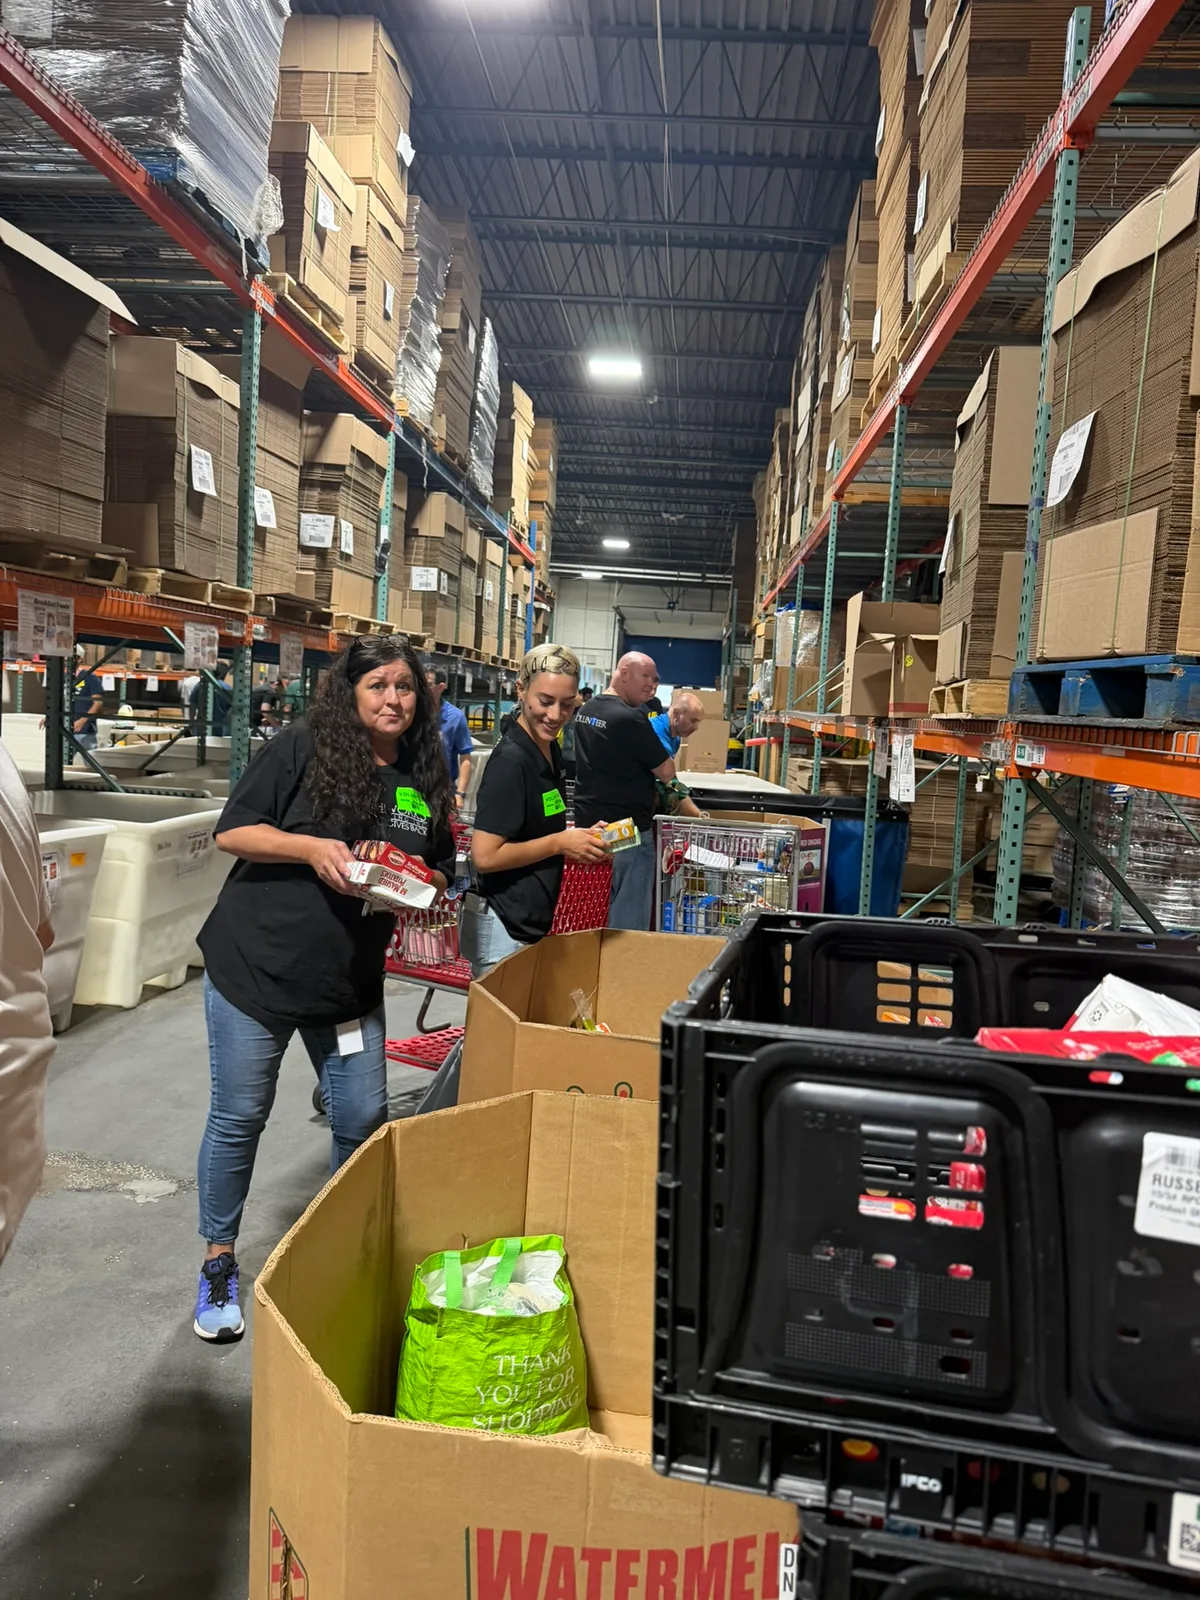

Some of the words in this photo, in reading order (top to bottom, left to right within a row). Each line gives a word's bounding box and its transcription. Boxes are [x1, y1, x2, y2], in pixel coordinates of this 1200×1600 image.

[575, 712, 607, 729] OLUNTEER
[410, 823, 428, 836] BACK
[379, 877, 400, 893] MASHED
[380, 869, 407, 887] POTATOES
[493, 1340, 572, 1376] THANK
[475, 1383, 533, 1405] YOU
[535, 1365, 576, 1399] FOR
[472, 1384, 580, 1432] SHOPPING
[900, 1472, 943, 1494] IFCO
[475, 1526, 782, 1600] WATERMEL
